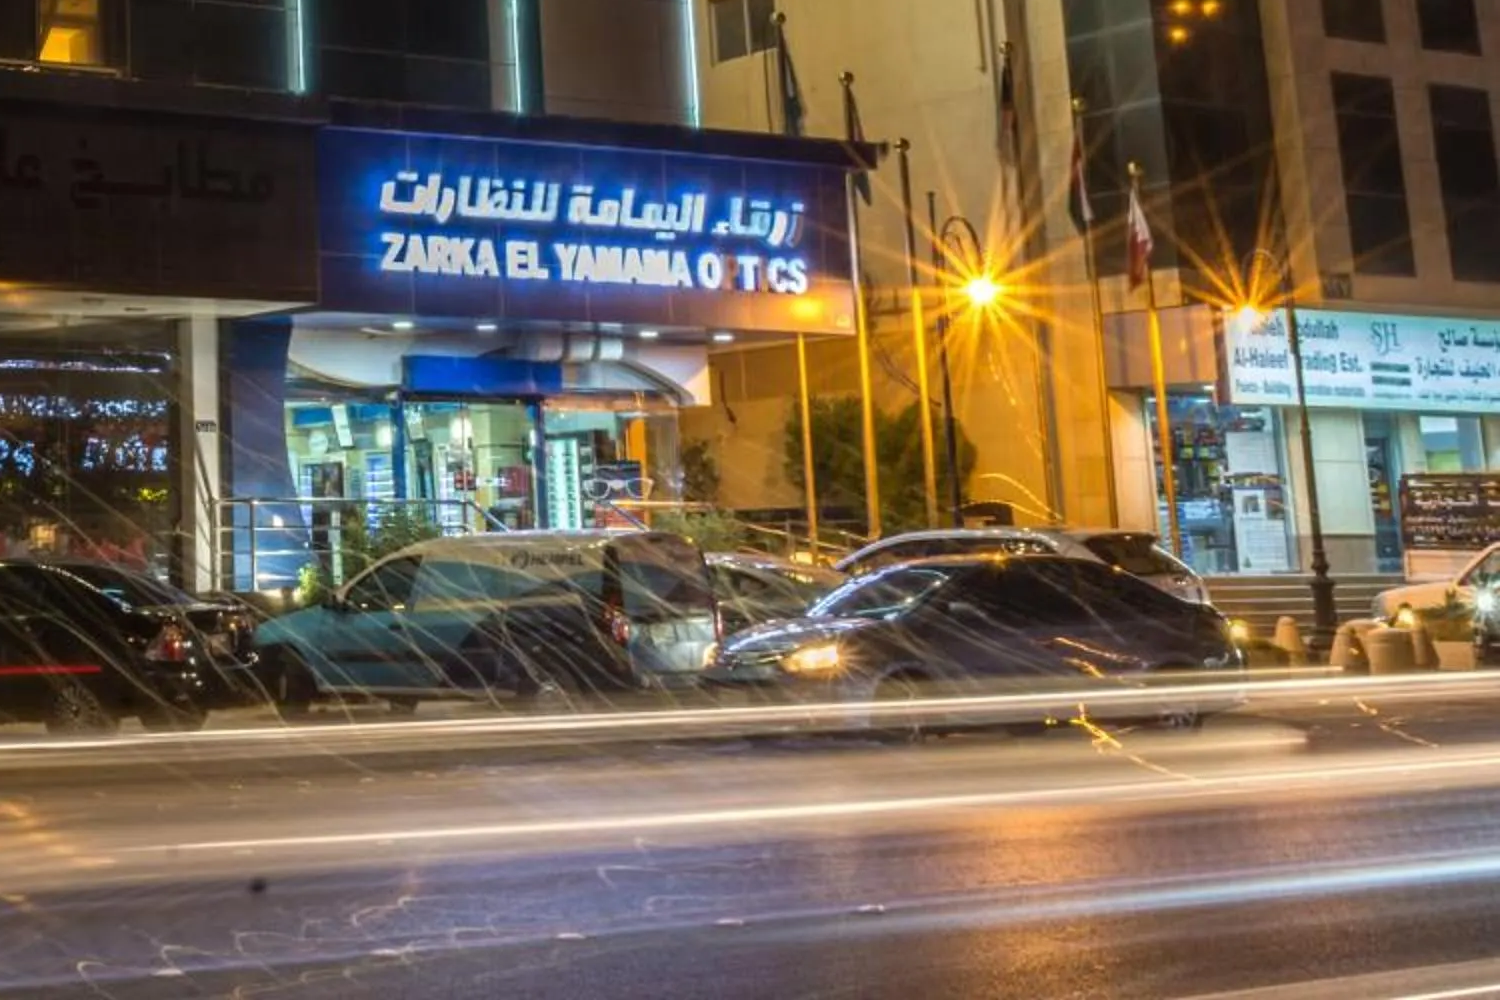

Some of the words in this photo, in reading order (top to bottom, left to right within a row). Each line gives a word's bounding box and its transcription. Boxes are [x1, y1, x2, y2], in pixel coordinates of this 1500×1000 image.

[567, 185, 706, 240] اليمامة
[710, 197, 805, 248] زرقاء
[381, 233, 500, 278] ZARKA
[506, 240, 550, 280] EL
